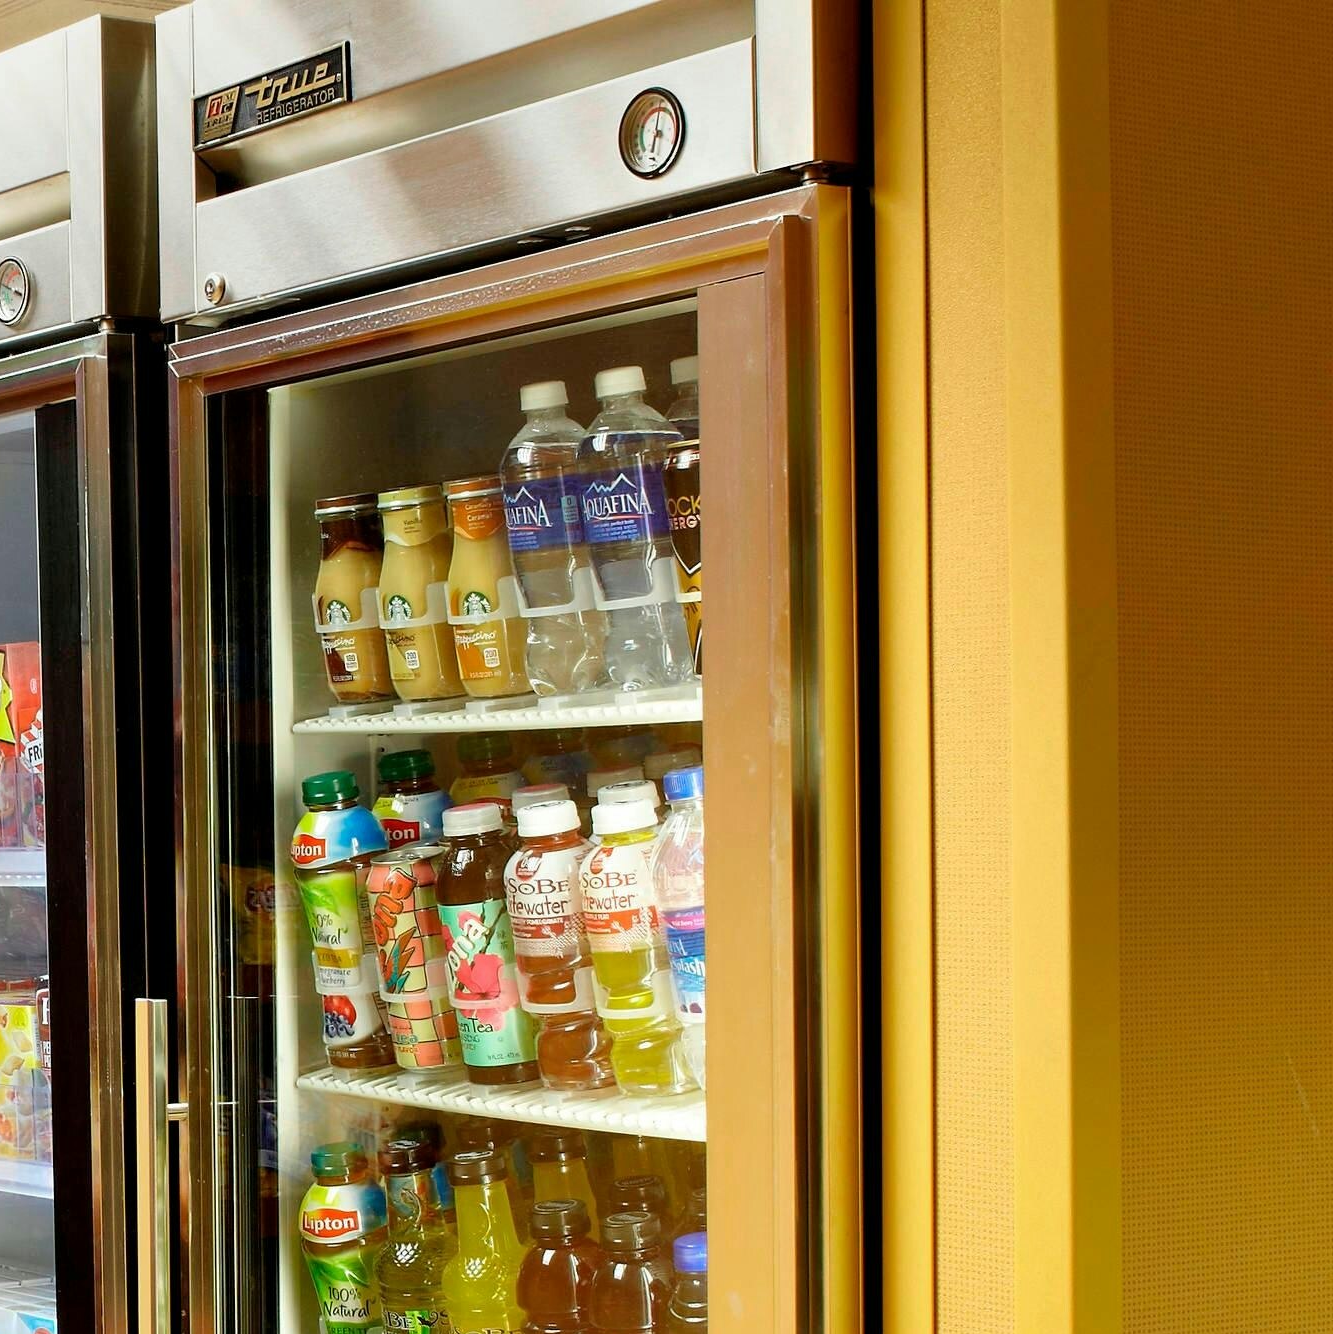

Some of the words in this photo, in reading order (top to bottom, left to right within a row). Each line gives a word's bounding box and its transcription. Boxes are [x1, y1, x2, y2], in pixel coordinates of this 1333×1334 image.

[245, 62, 337, 109] true
[257, 88, 336, 125] REFRIGERATOR
[506, 499, 551, 527] UAFINA
[583, 486, 654, 522] AQUAFINA
[470, 1017, 494, 1033] Tea
[303, 1213, 356, 1233] Lipton
[328, 1285, 362, 1305] 100%
[323, 1299, 371, 1320] Natural
